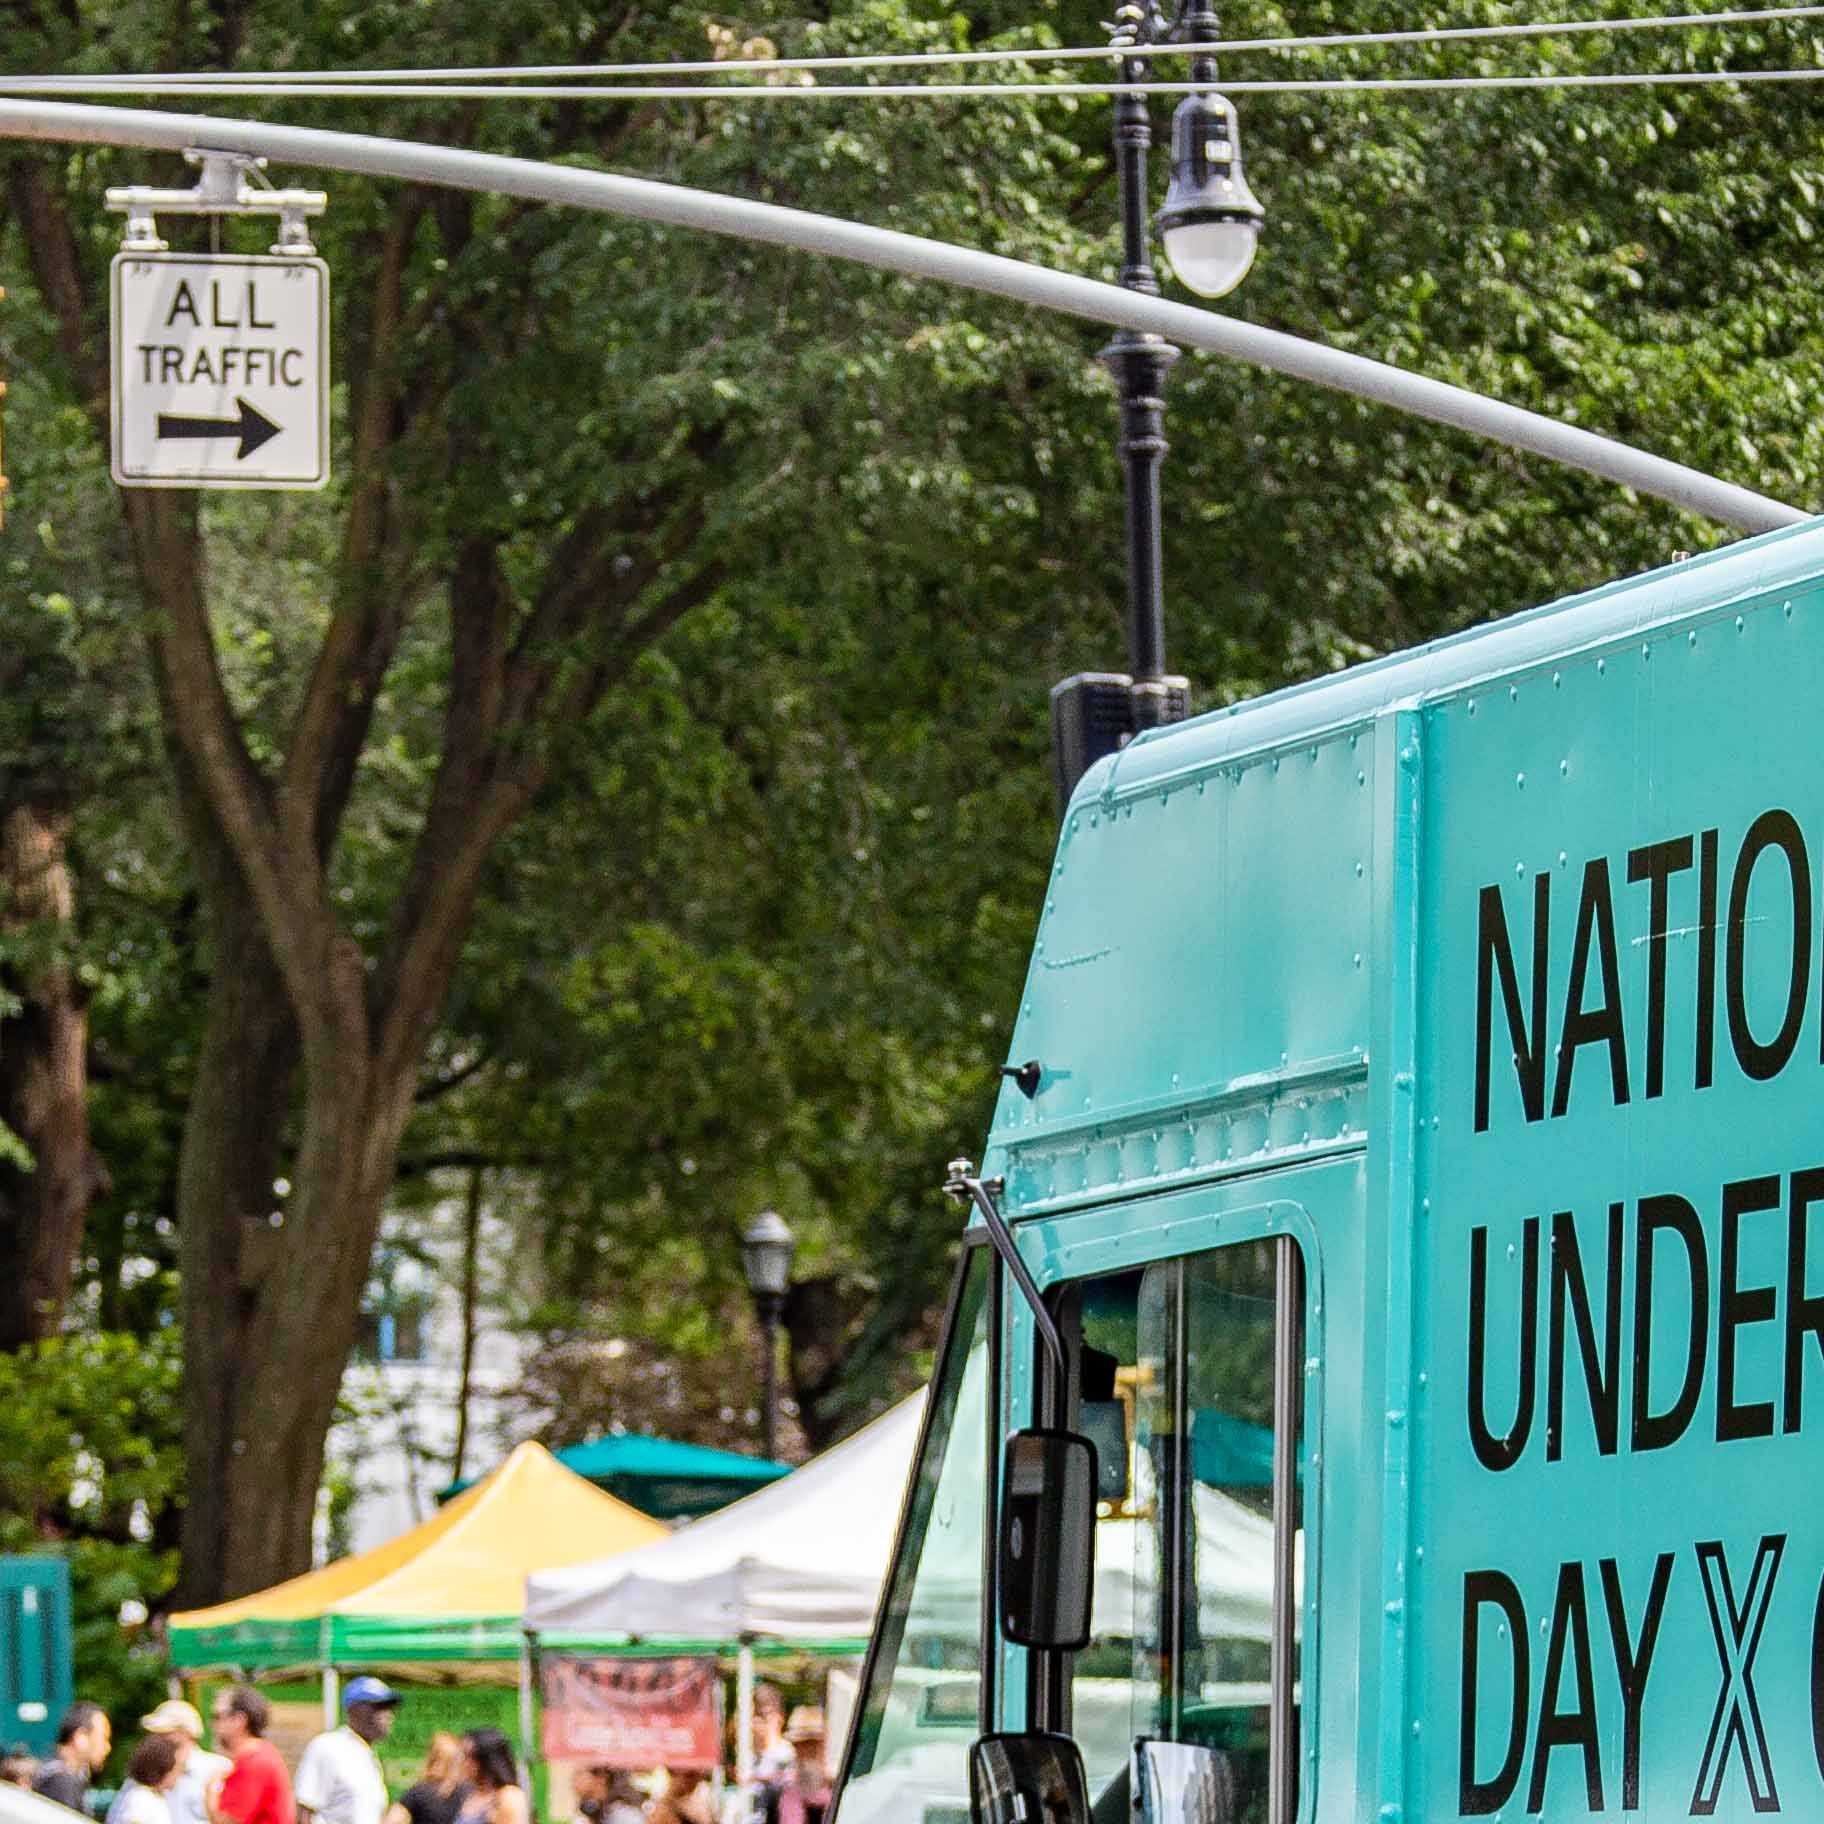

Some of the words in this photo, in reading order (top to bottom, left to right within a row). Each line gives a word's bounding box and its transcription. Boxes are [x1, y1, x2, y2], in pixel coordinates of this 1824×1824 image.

[165, 279, 276, 329] ALL
[137, 344, 304, 387] TRAFFIC
[1458, 1551, 1676, 1818] DAY
[1688, 1532, 1789, 1817] X
